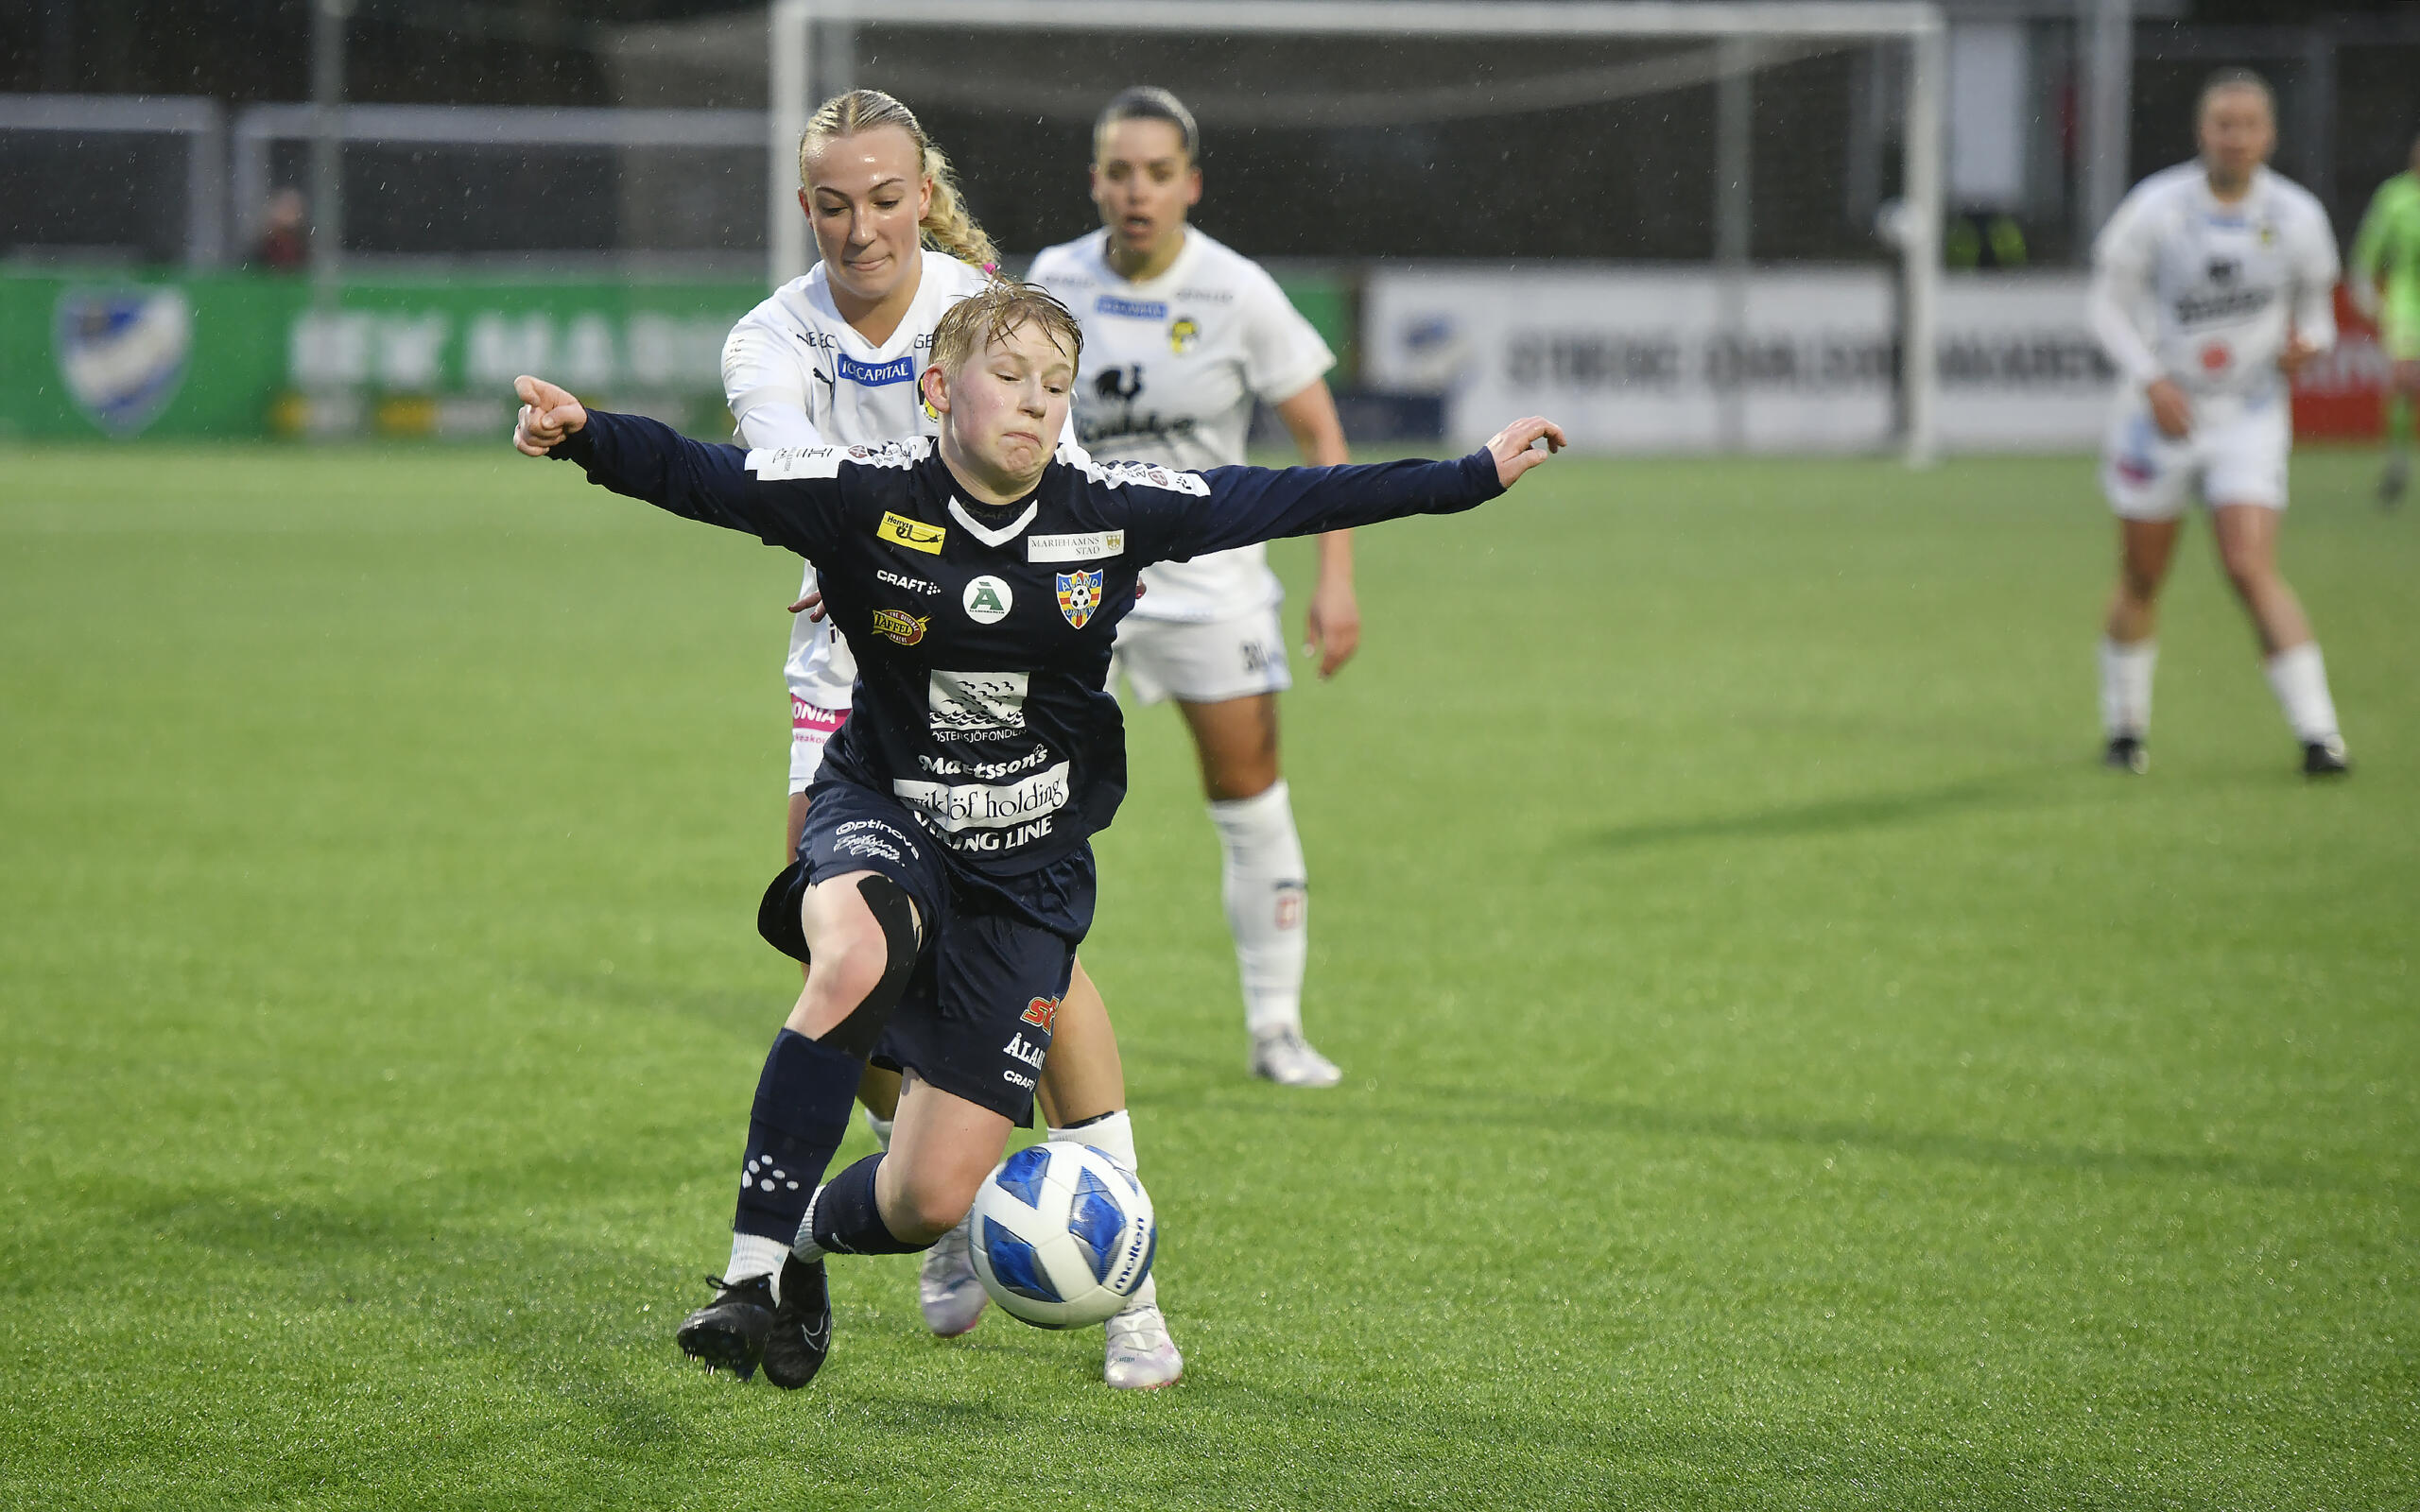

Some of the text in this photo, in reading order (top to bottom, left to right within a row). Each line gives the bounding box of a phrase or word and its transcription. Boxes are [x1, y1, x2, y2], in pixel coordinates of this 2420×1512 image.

[887, 515, 909, 528] Harrys
[1031, 535, 1099, 548] MARIEHAMNS
[1076, 545, 1100, 556] STAD
[877, 569, 926, 593] CRAFT
[1066, 606, 1095, 617] UNITED
[985, 778, 1063, 818] holding
[836, 819, 919, 860] Optinova
[1005, 815, 1053, 850] LINE
[1115, 1217, 1145, 1290] molten
